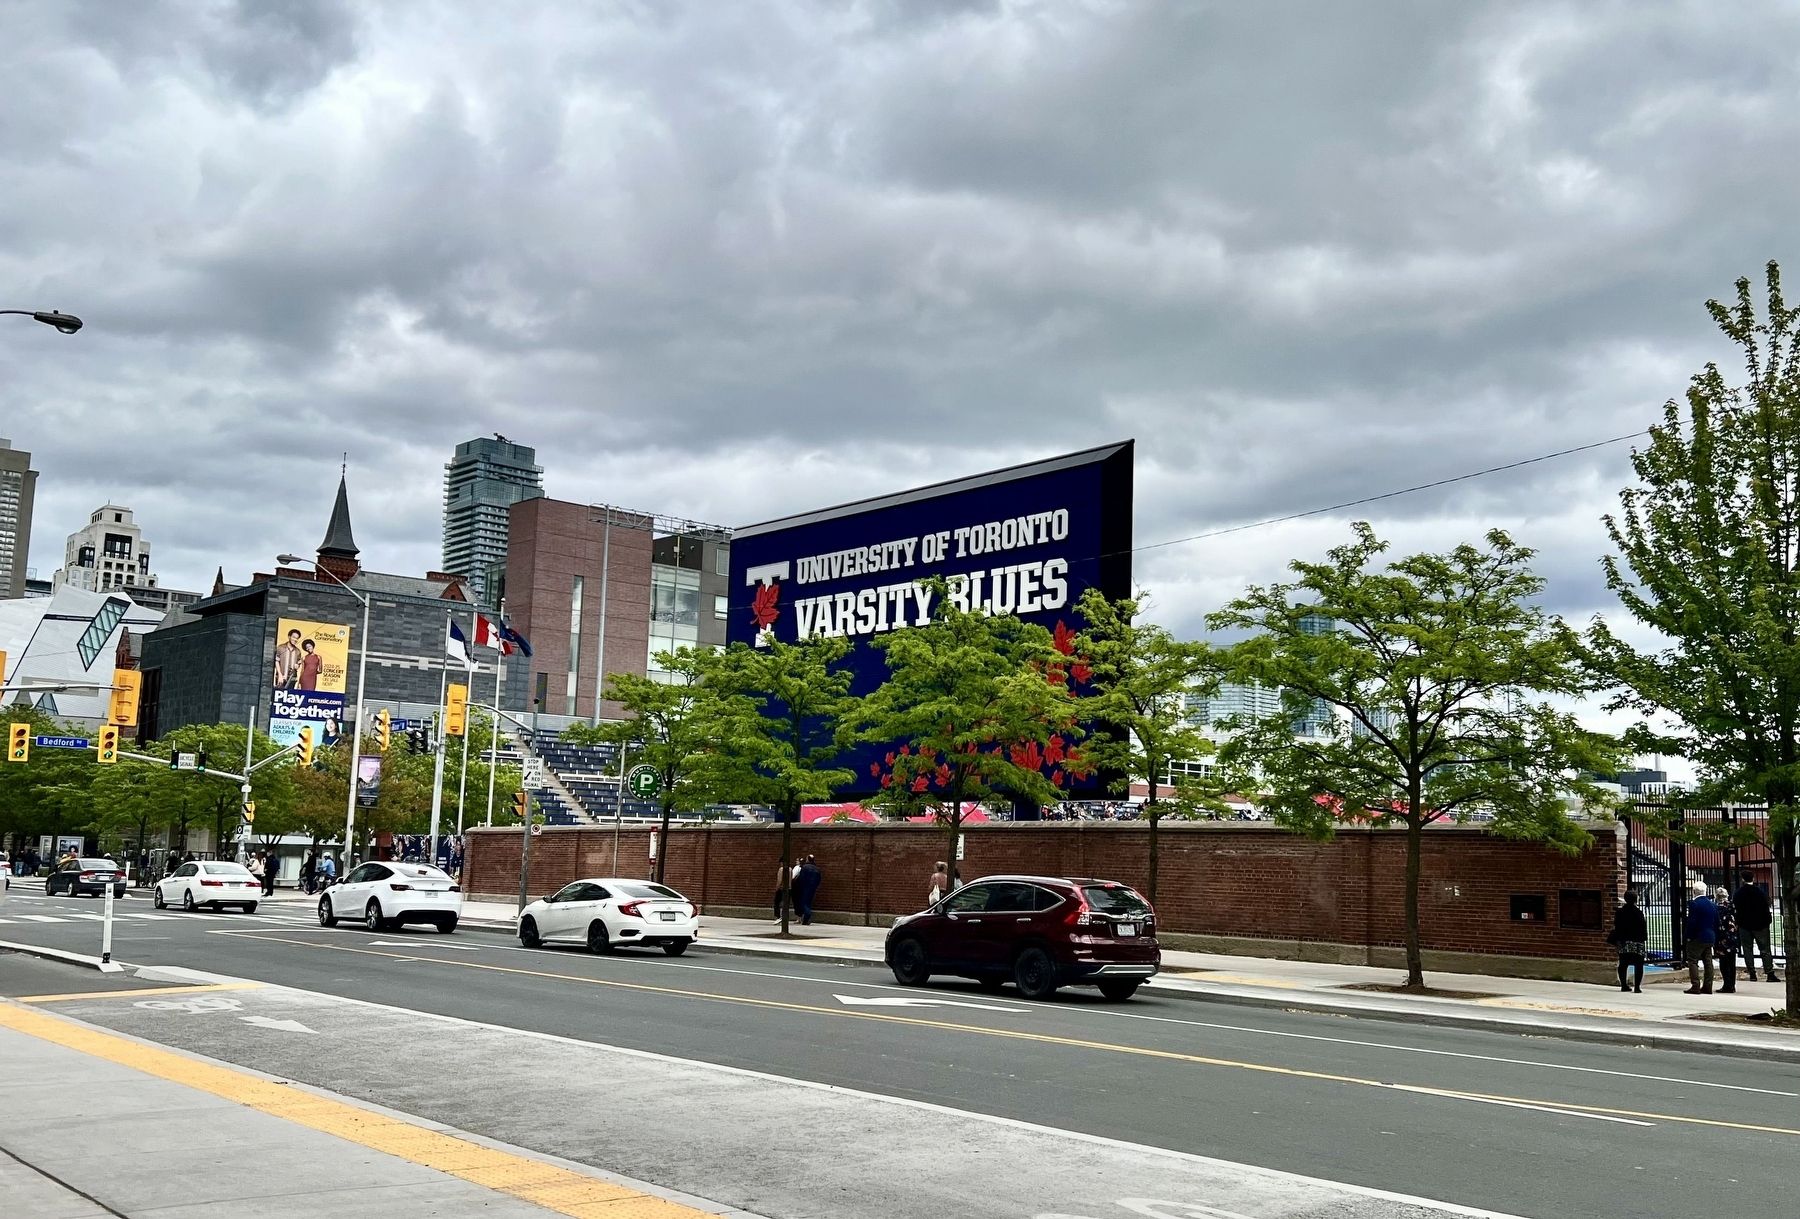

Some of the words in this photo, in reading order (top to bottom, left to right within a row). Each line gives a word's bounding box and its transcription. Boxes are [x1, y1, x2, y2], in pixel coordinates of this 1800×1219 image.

[797, 537, 918, 585] UNIVERSITY
[922, 531, 950, 564] OF
[954, 508, 1069, 558] TORONTO
[795, 582, 933, 642] VARSITY
[274, 690, 305, 706] Play
[273, 703, 342, 719] Together!
[43, 738, 75, 746] Bedford
[640, 774, 654, 788] P
